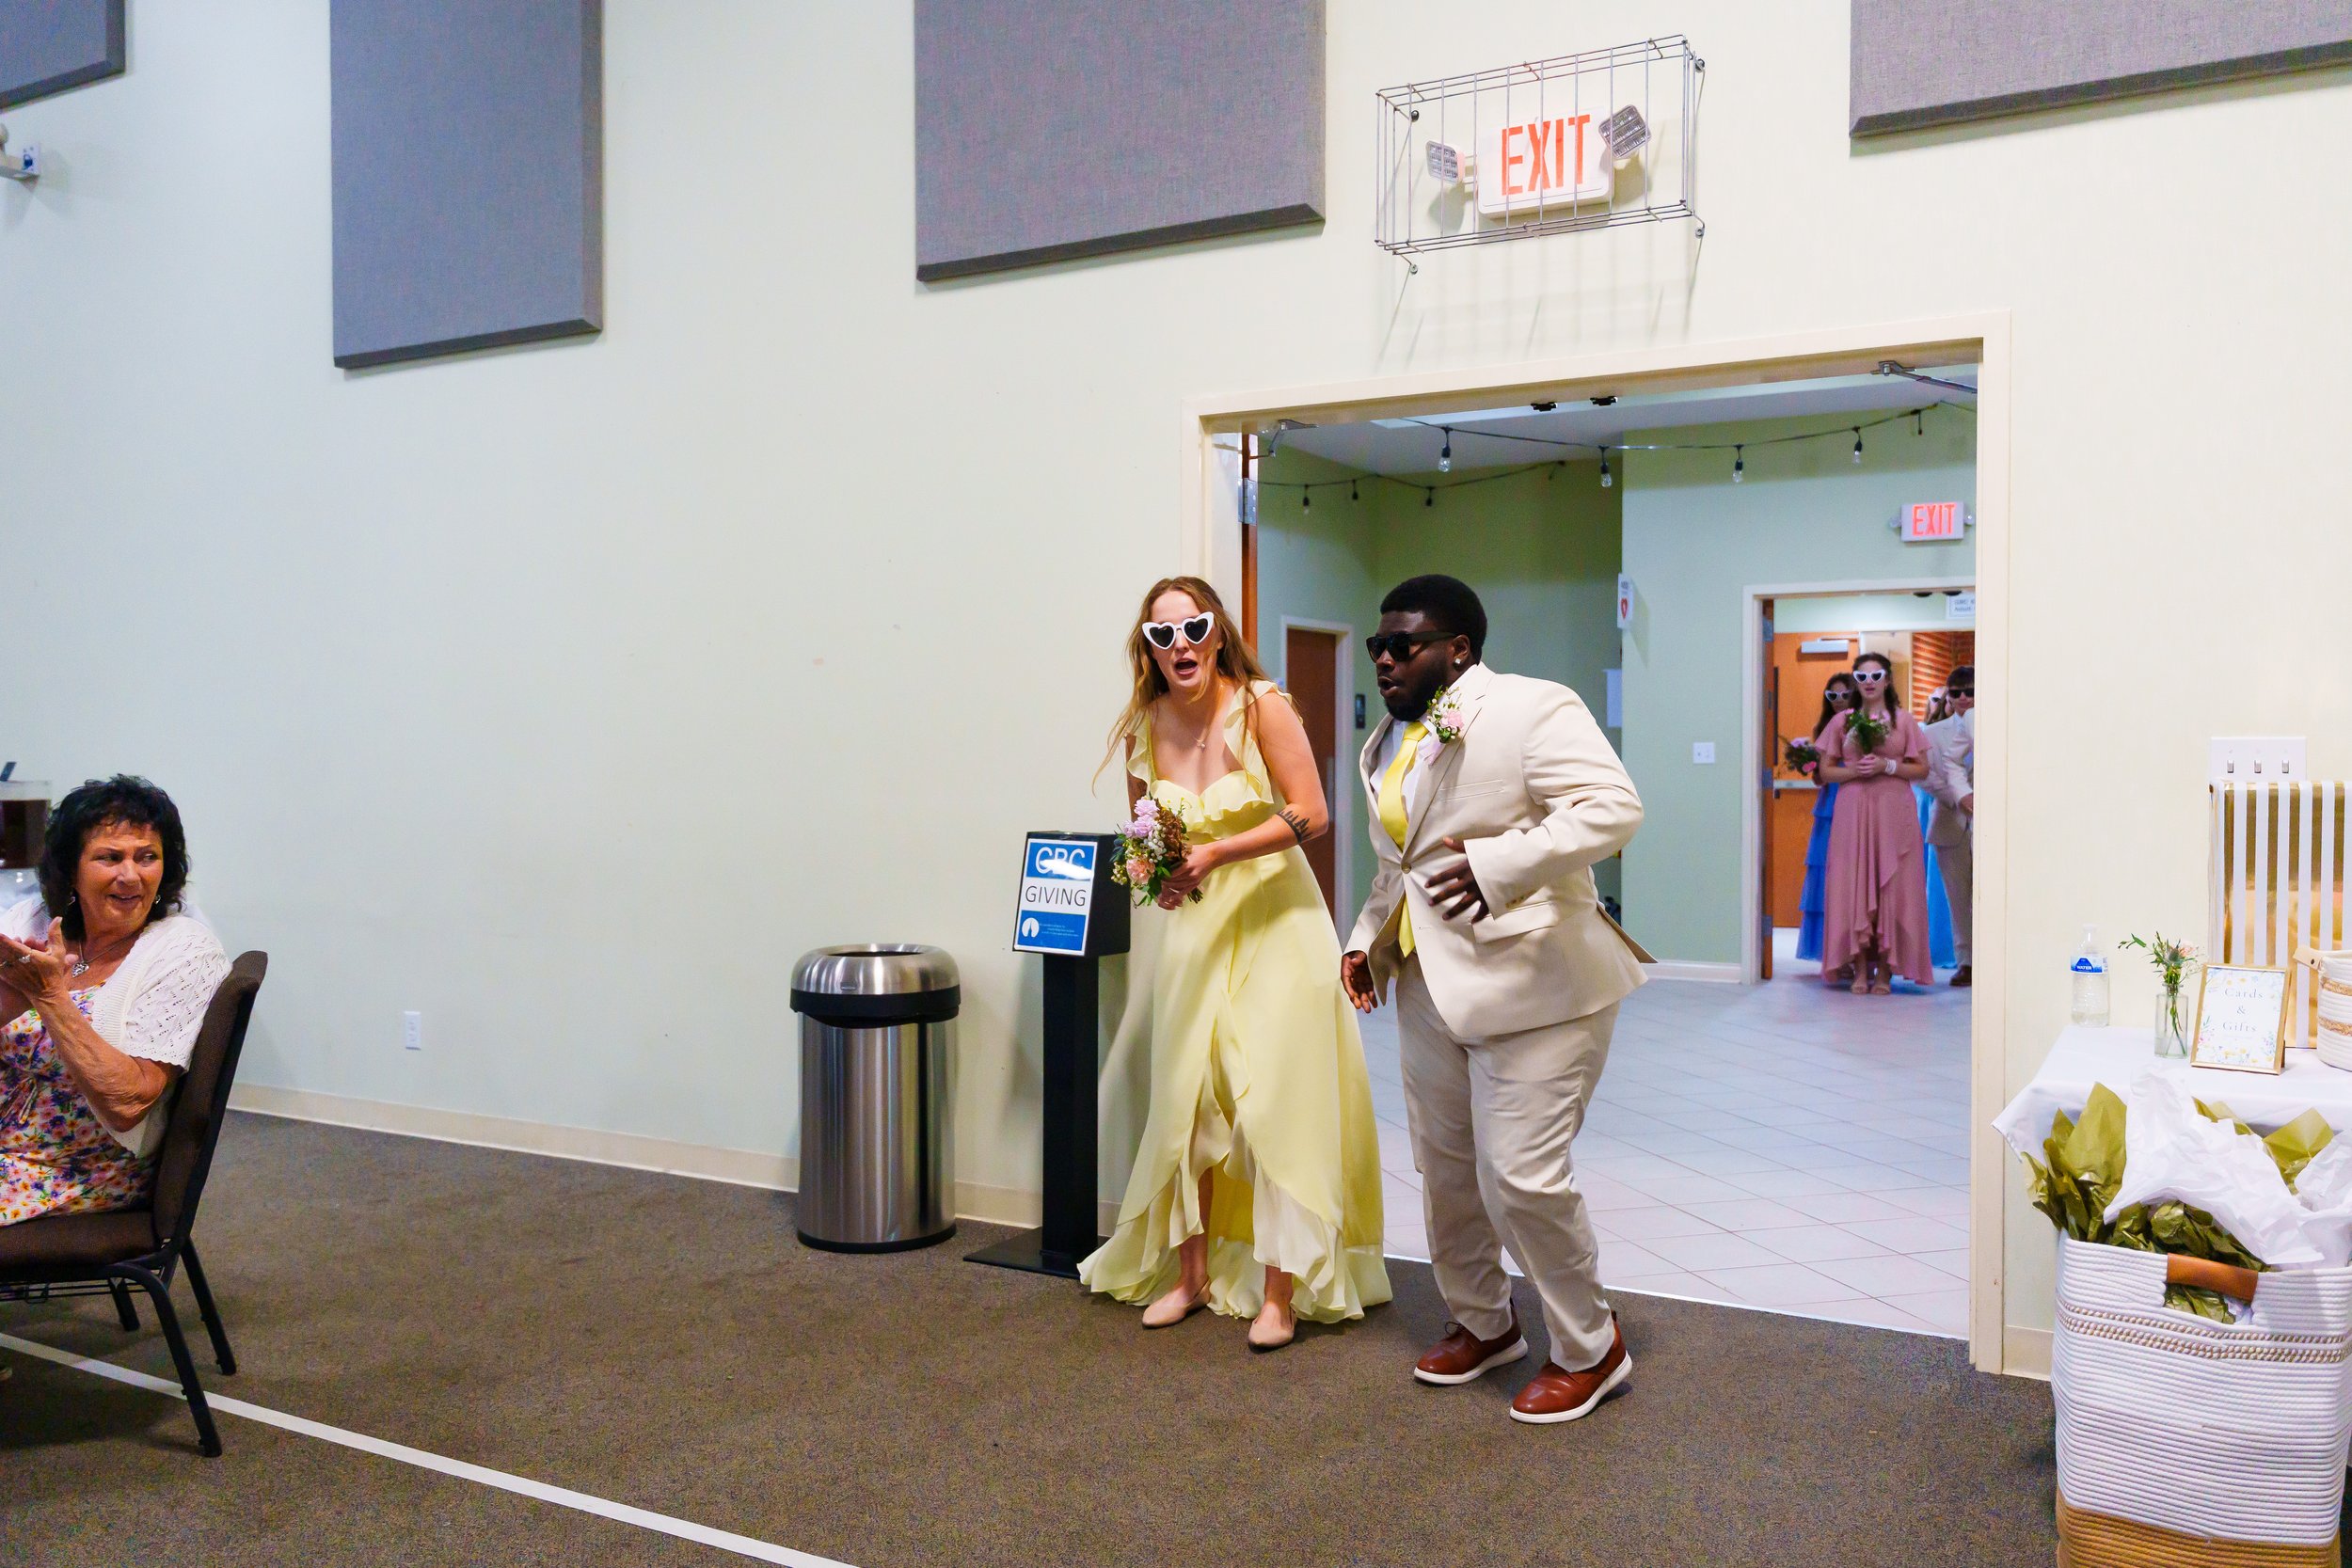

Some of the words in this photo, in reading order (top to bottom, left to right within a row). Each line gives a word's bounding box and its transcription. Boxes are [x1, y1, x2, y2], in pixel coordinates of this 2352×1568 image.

[1501, 114, 1591, 197] EXIT
[1912, 501, 1958, 536] EXIT
[1025, 886, 1087, 907] GIVING
[2224, 988, 2265, 999] Cards
[2236, 1005, 2247, 1014] &
[2222, 1022, 2257, 1032] Gifts
